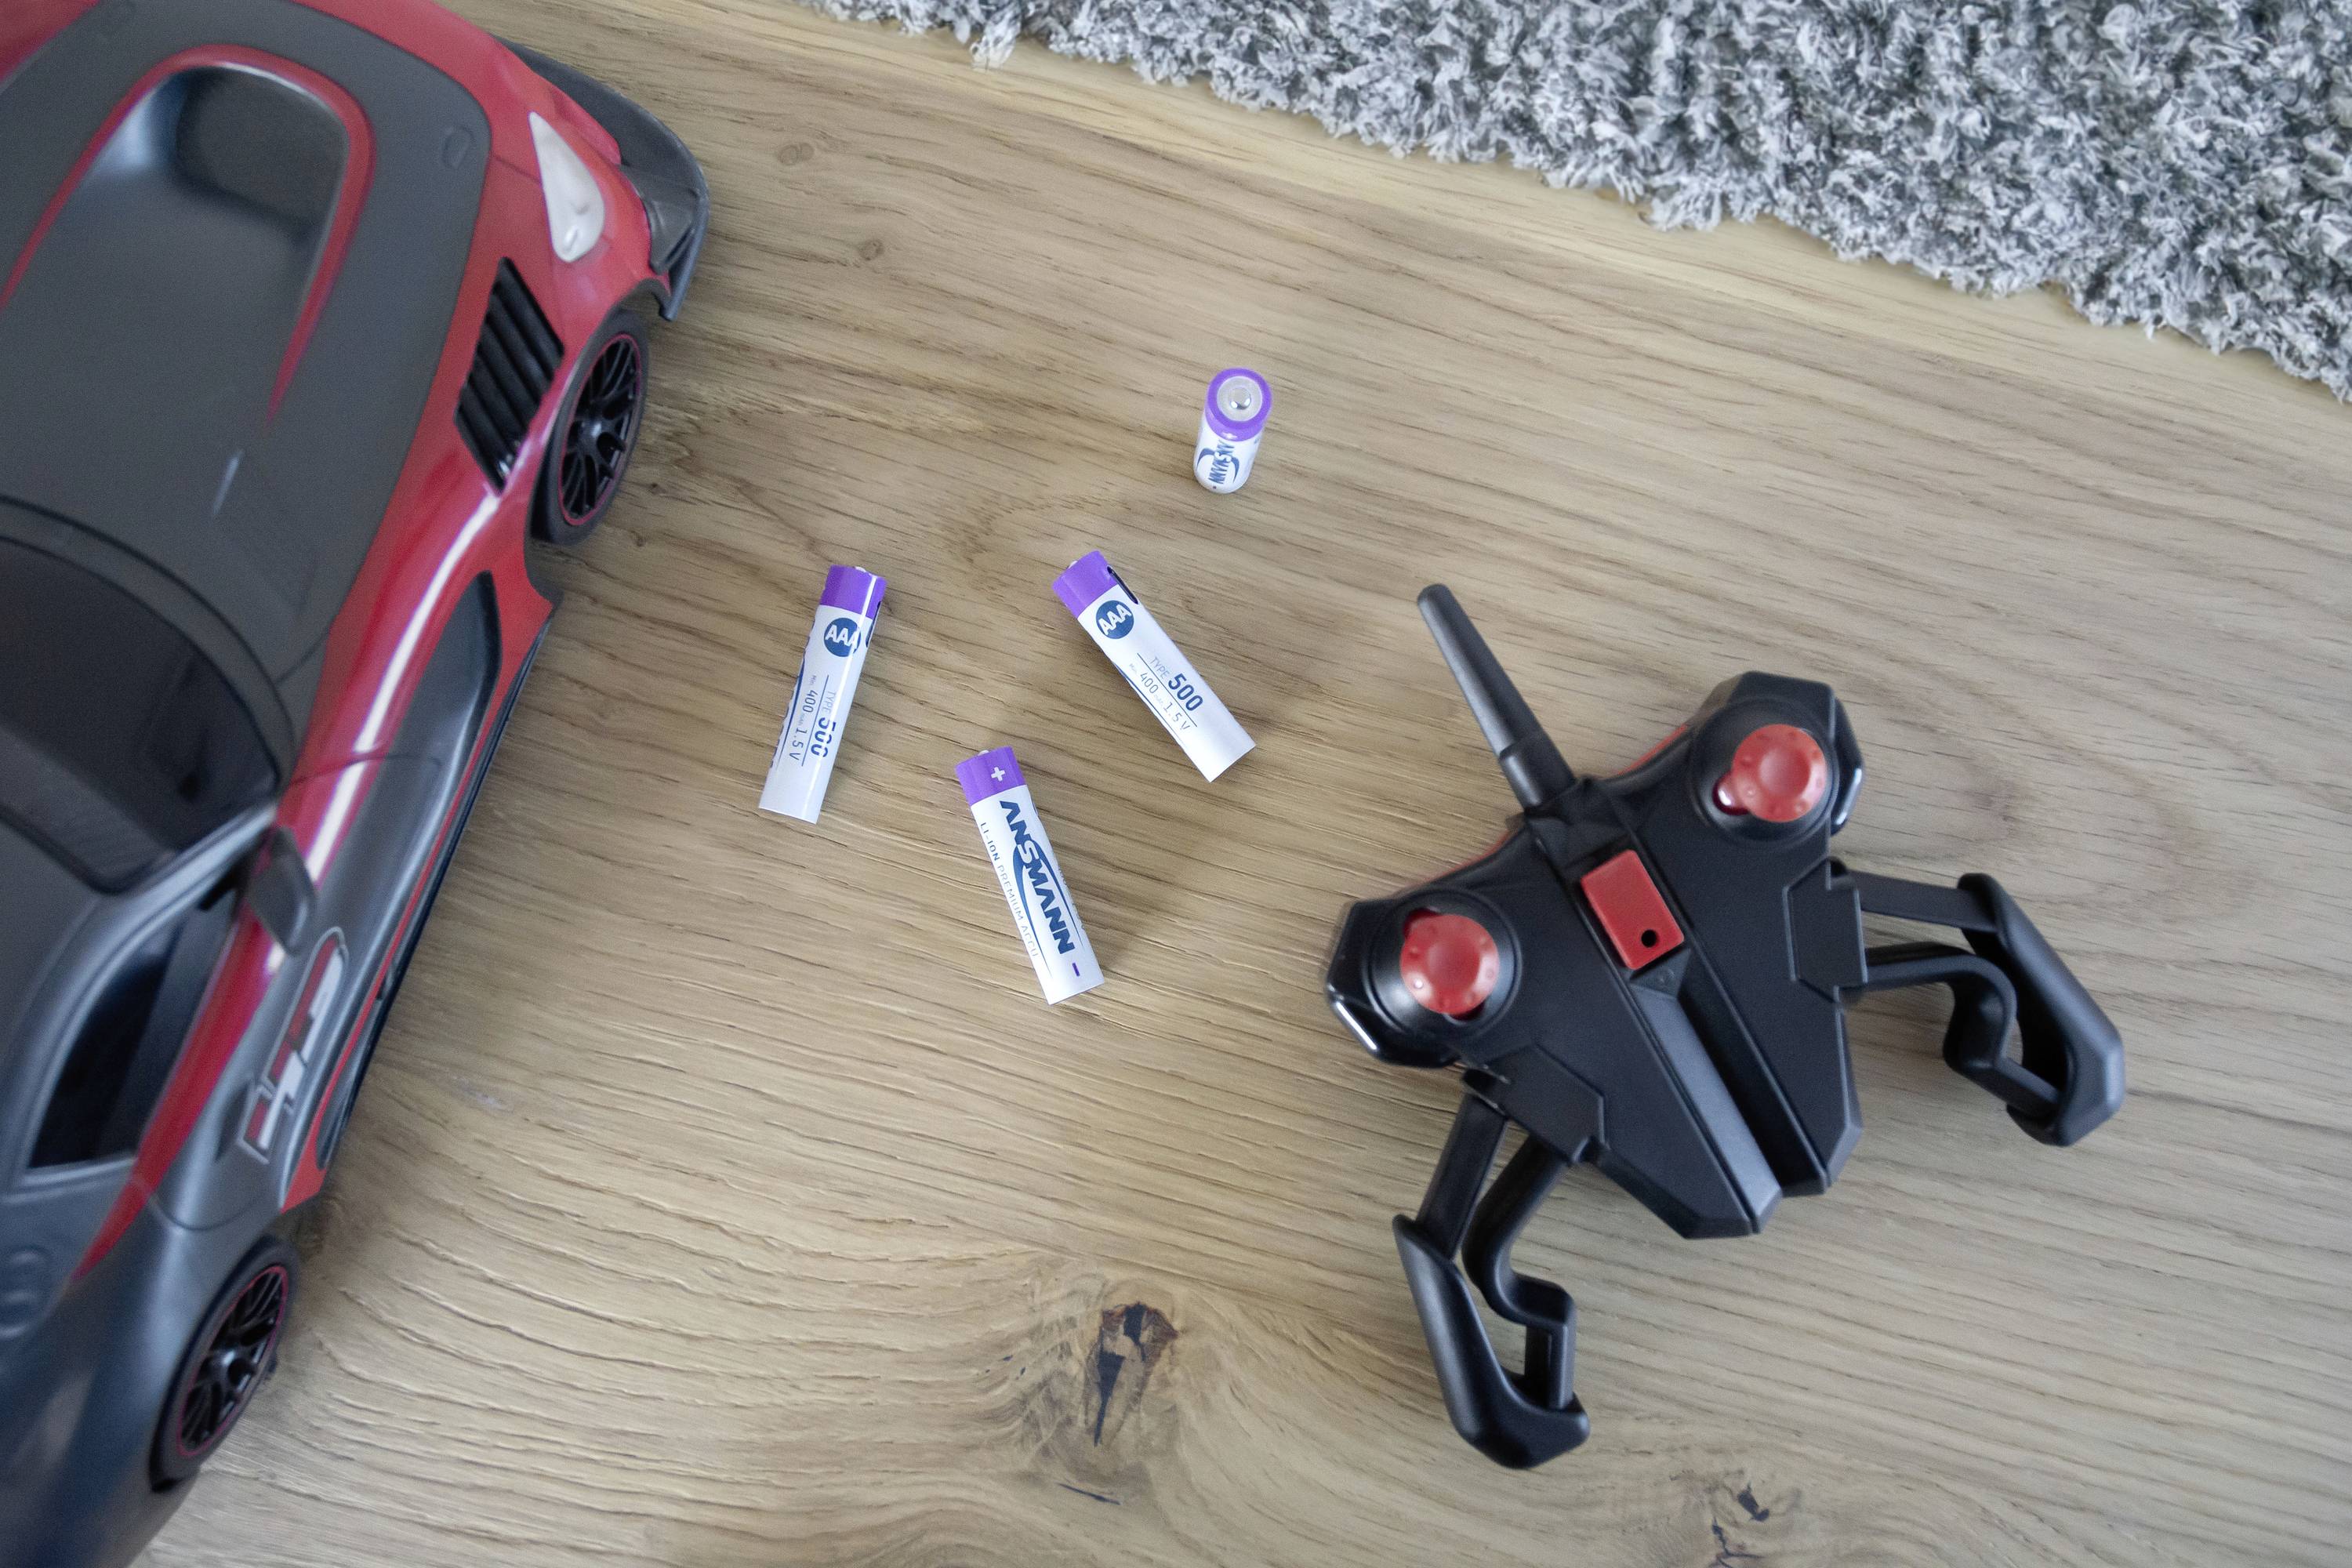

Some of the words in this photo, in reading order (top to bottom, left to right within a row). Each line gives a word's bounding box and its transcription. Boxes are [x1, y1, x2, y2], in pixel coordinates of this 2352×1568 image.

[825, 624, 860, 647] AAA
[1098, 604, 1132, 636] AAA
[803, 689, 818, 714] 400
[1140, 672, 1159, 694] 400
[1150, 656, 1171, 679] TYPE
[1168, 673, 1203, 711] 500
[811, 716, 837, 758] 500
[980, 822, 1000, 862] LI-ION
[999, 865, 1024, 921] PREMIUM
[1000, 800, 1076, 955] ANSMANN
